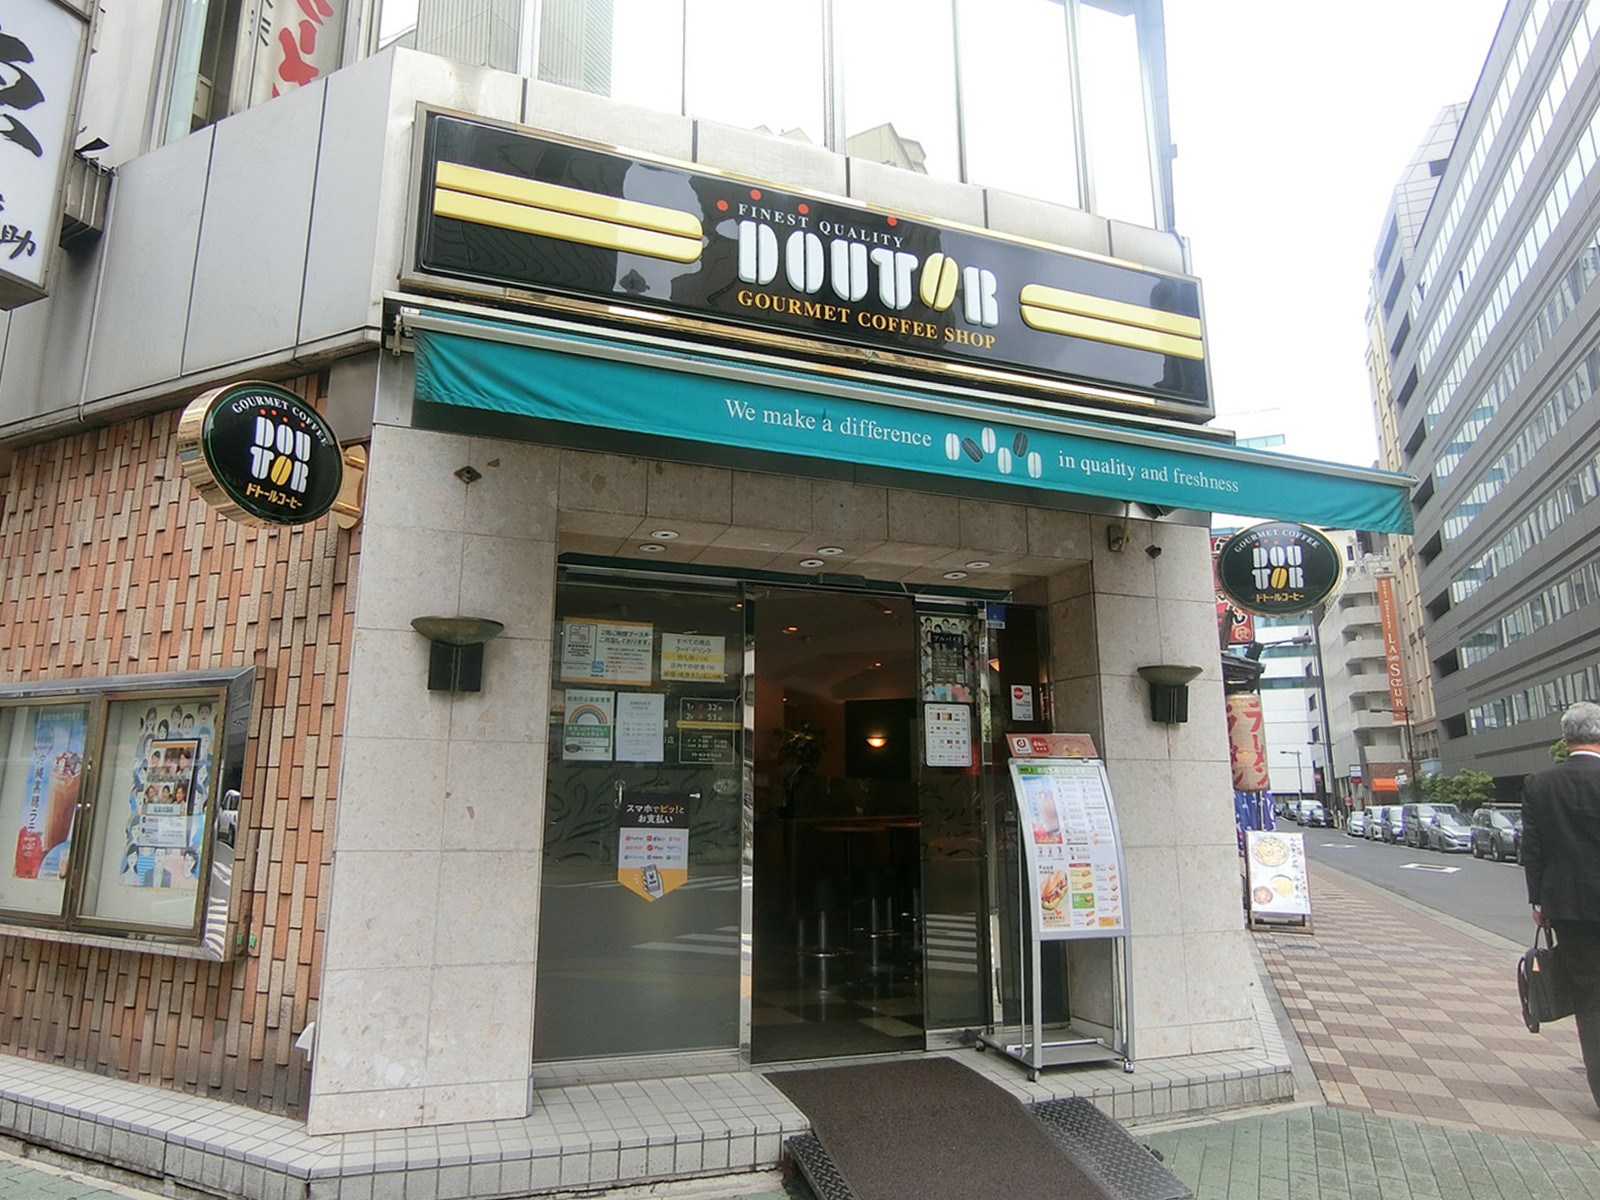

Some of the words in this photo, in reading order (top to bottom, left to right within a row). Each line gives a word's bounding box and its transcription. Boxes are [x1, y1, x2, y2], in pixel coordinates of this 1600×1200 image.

[737, 203, 810, 229] FINEST
[818, 220, 904, 248] QUALITY
[738, 219, 999, 328] DOUTOR
[737, 290, 851, 324] GOURMET
[857, 311, 938, 340] COFFEE
[944, 326, 996, 350] SHOP
[231, 395, 289, 414] GOURMET
[292, 406, 329, 447] COFFEE
[724, 398, 756, 422] We
[762, 408, 816, 431] make
[822, 418, 833, 433] a
[839, 416, 933, 448] difference
[1058, 451, 1075, 468] in
[1080, 456, 1136, 482] quality
[1141, 463, 1168, 483] and
[1173, 467, 1240, 493] freshness
[245, 482, 303, 509] ドトールコーヒー
[1234, 529, 1279, 553] GOURMET
[1282, 529, 1320, 549] COFFEE
[1256, 592, 1305, 603] ドトールコーヒー
[1242, 700, 1269, 788] ラーメン
[638, 814, 673, 824] お支払い
